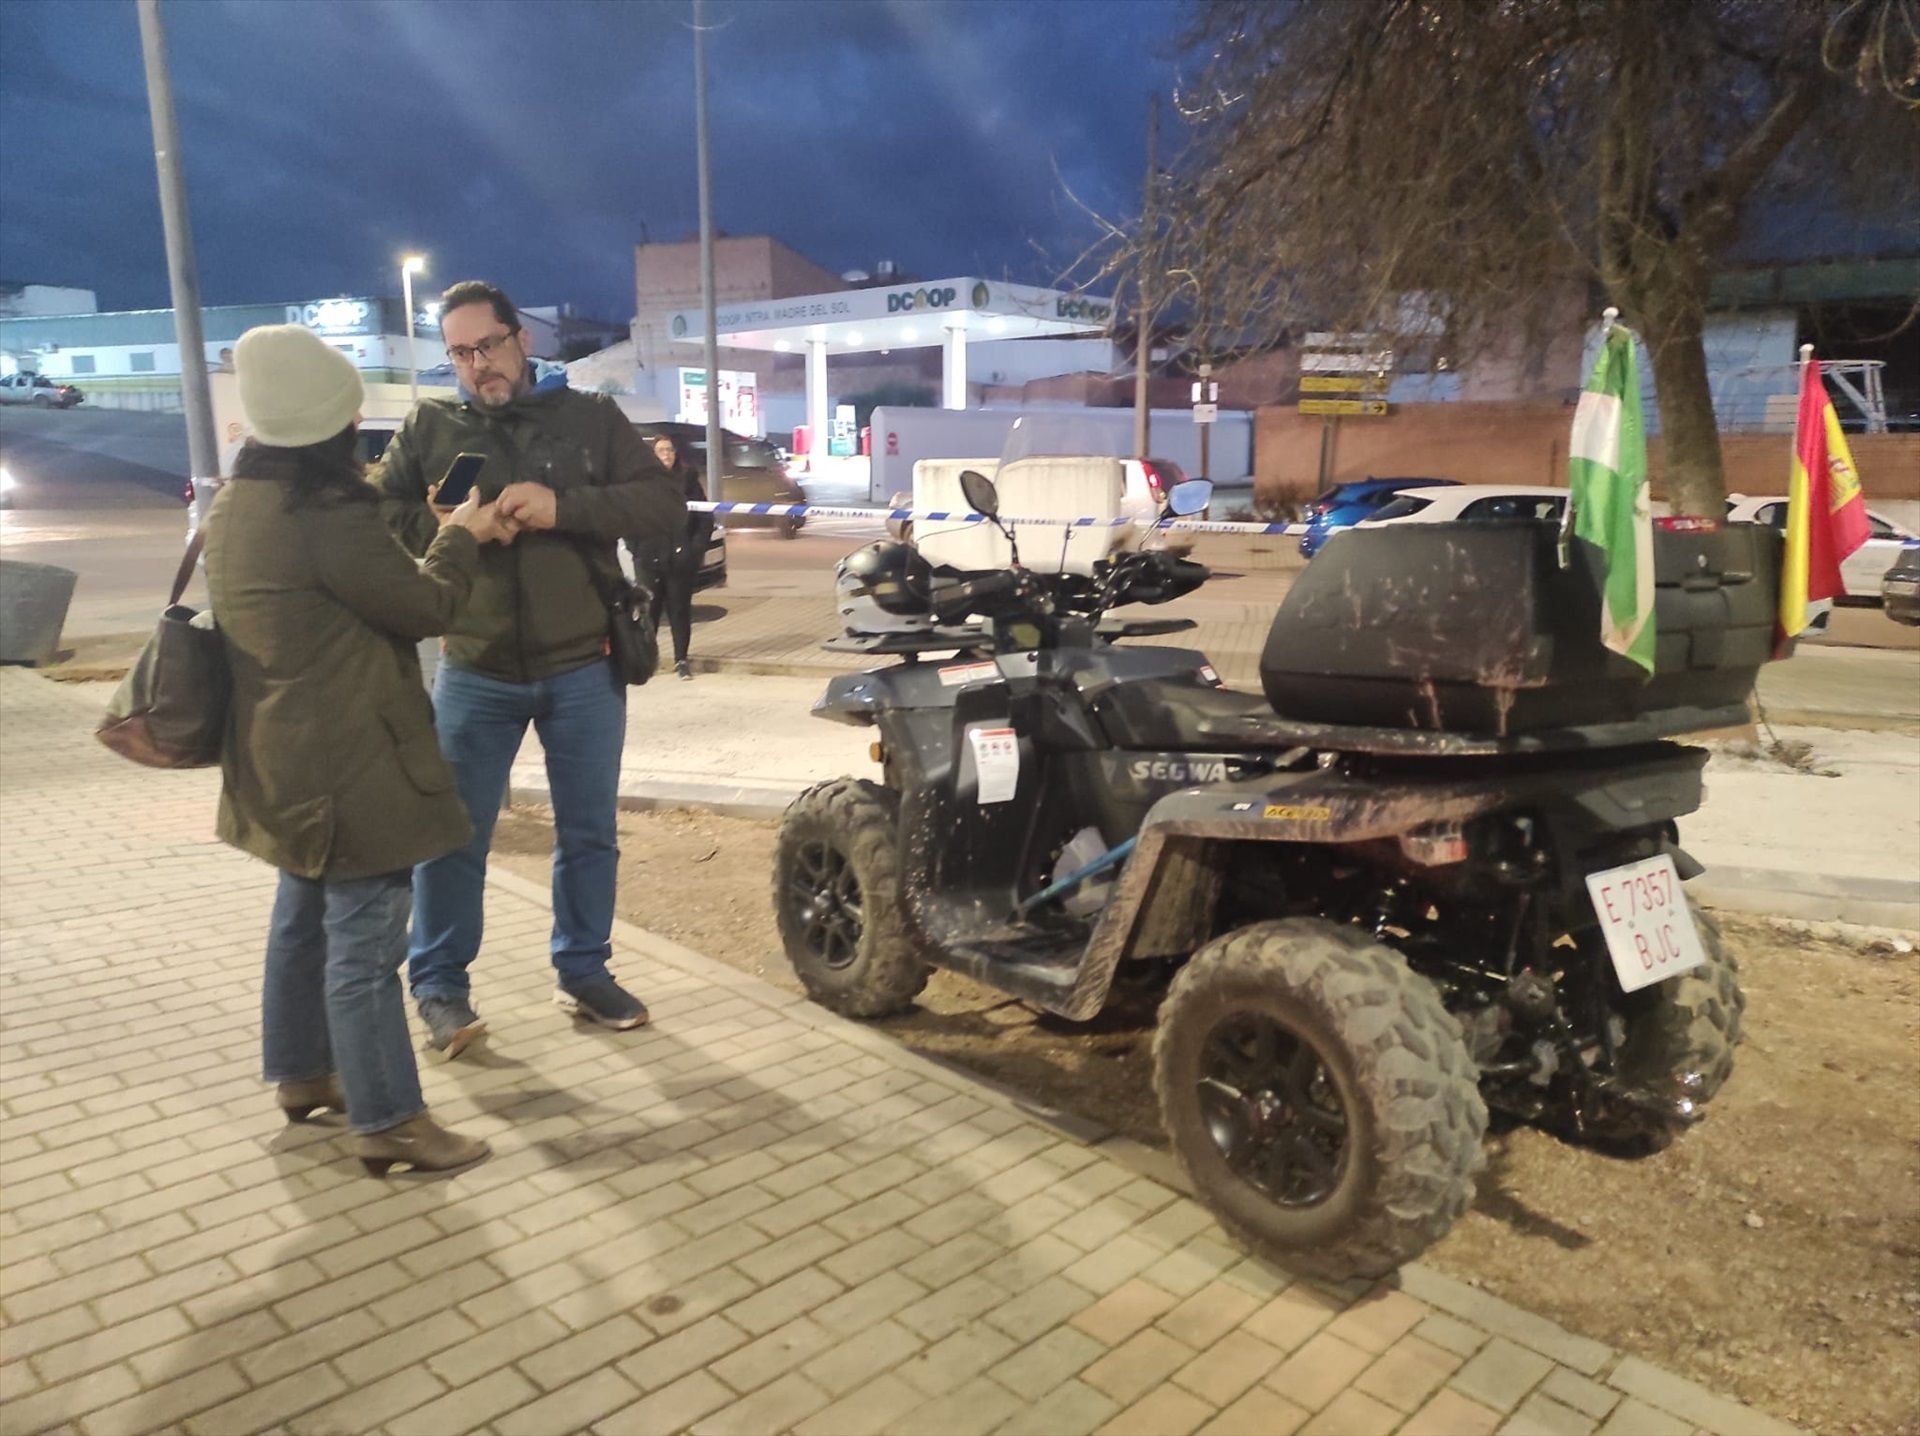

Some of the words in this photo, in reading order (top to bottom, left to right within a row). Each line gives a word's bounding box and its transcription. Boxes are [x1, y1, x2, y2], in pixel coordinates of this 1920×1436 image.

[887, 287, 957, 313] DCOOP
[1130, 760, 1232, 783] SEGWA
[1601, 887, 1622, 923] E
[1622, 868, 1673, 917] 7357
[1634, 924, 1680, 970] BJC
